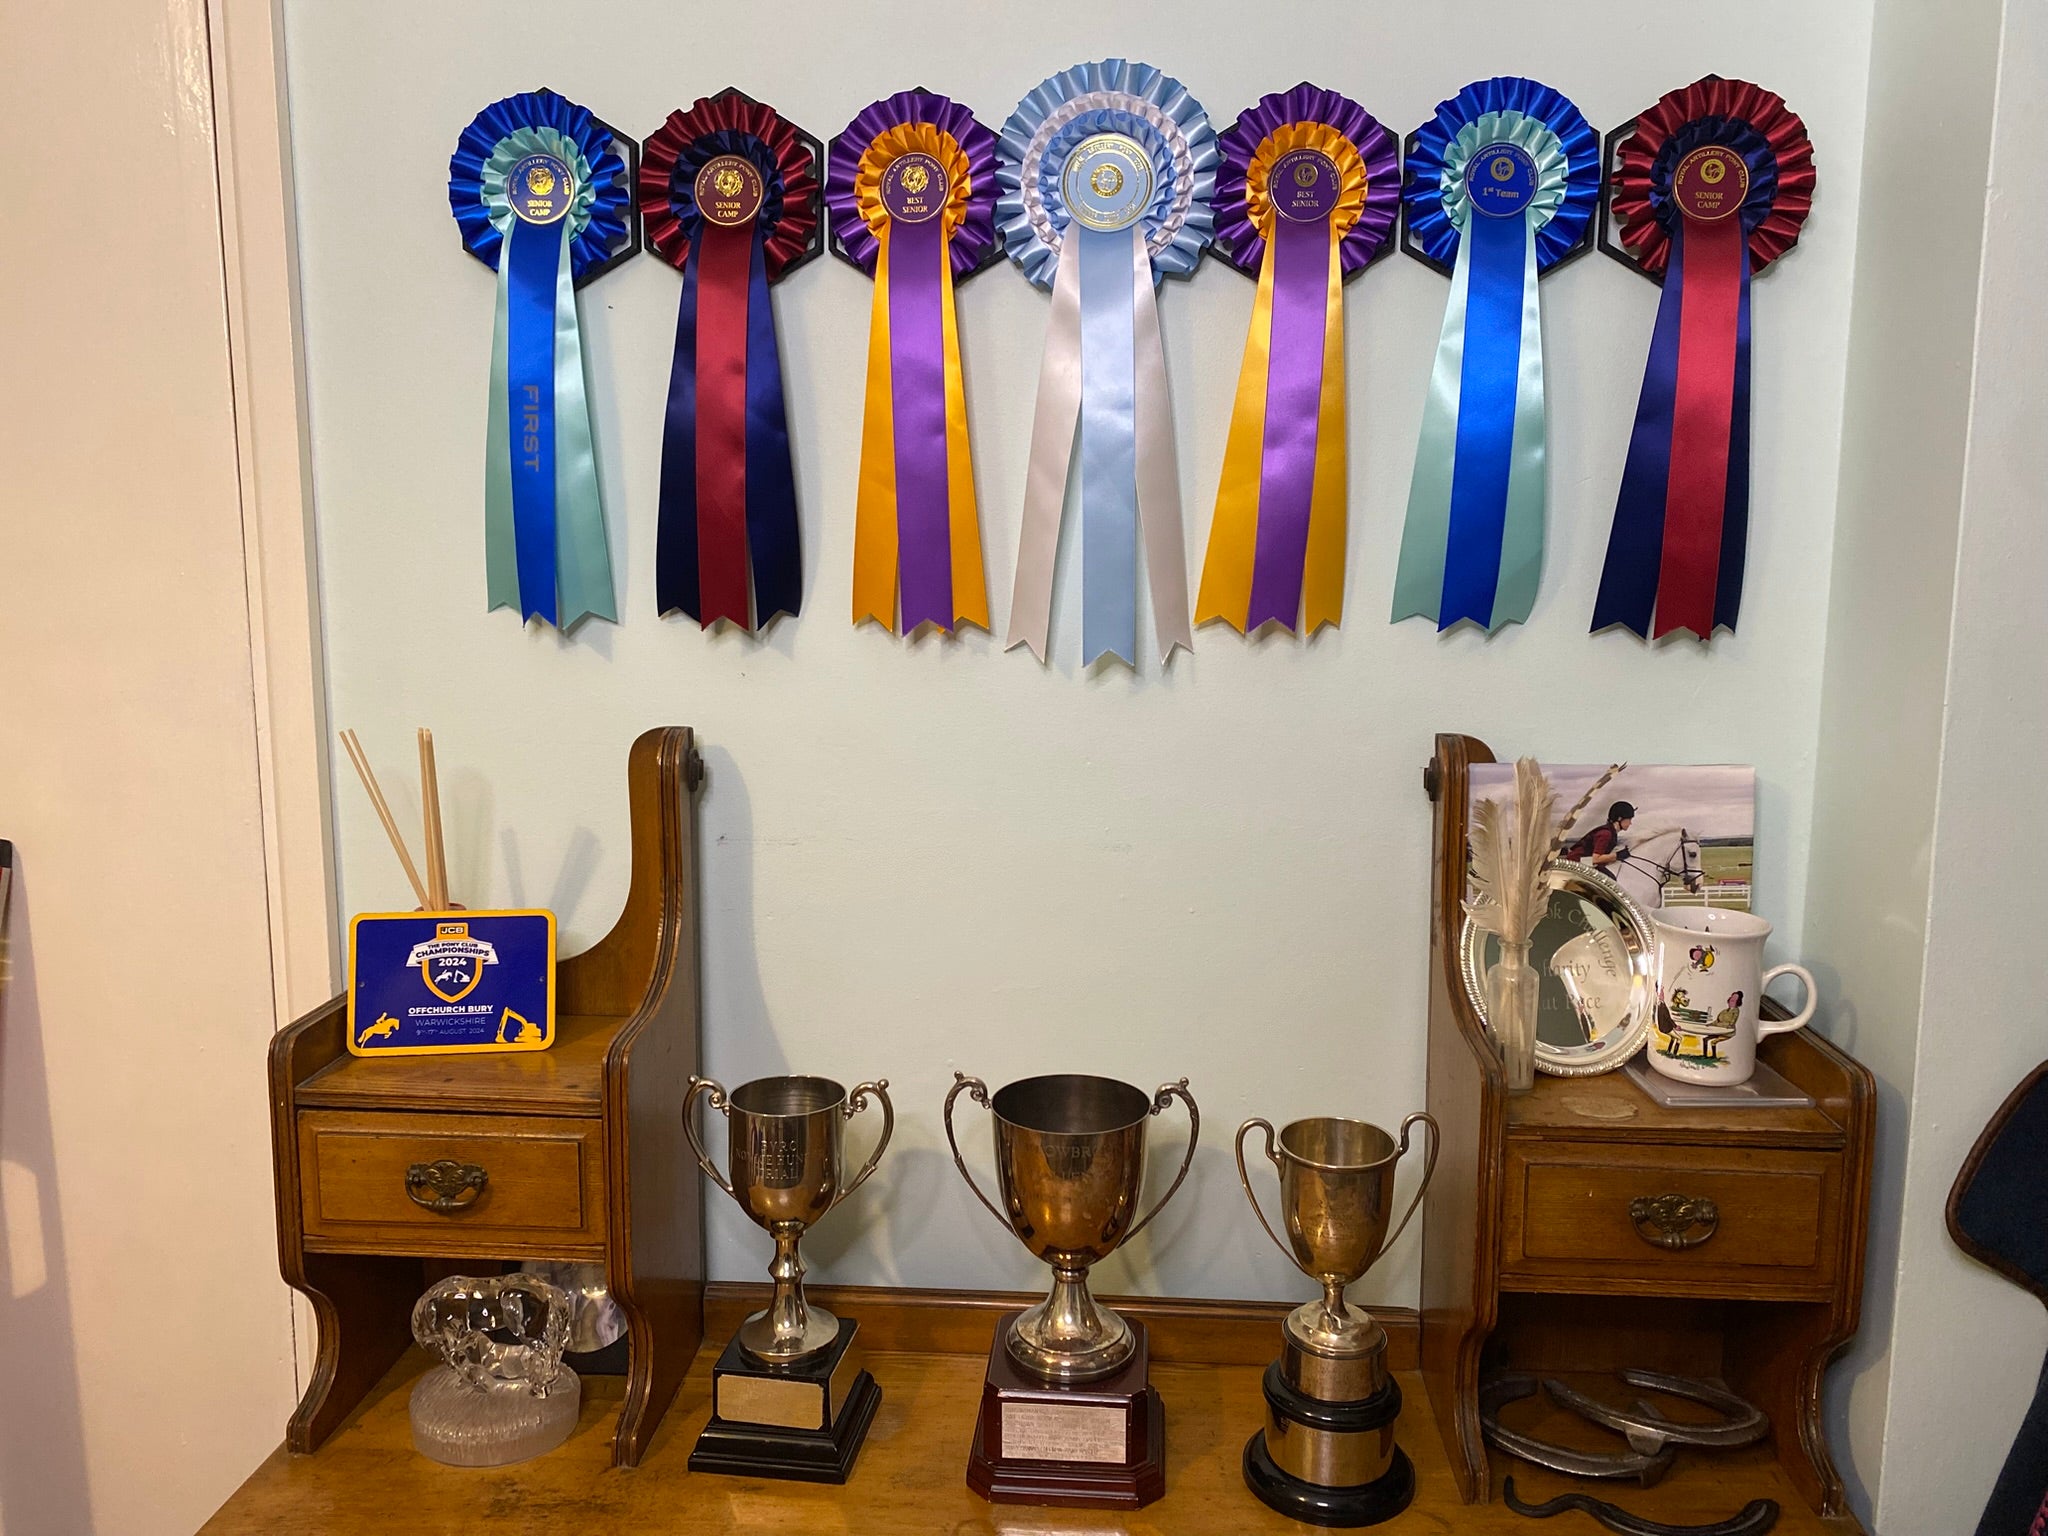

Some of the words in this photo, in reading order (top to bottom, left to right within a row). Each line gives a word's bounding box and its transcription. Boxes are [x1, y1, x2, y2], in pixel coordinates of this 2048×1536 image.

[1495, 188, 1519, 199] Team
[1695, 191, 1723, 200] SENIOR
[527, 200, 553, 208] SENIOR
[906, 196, 924, 204] BEST
[1291, 200, 1319, 208] SENIOR
[715, 201, 741, 209] SENIOR
[902, 205, 928, 214] SENIOR
[1697, 201, 1721, 209] CAMP
[529, 208, 551, 216] CAMP
[717, 210, 739, 218] CAMP
[523, 385, 539, 473] FIRST
[416, 947, 490, 958] CHAMPIONSHIPS
[438, 958, 467, 967] 2024
[1543, 959, 1590, 983] harity
[408, 1005, 466, 1014] OFFCHURCH
[467, 1005, 494, 1013] BURY
[415, 1017, 486, 1026] WARWICKSHIRE
